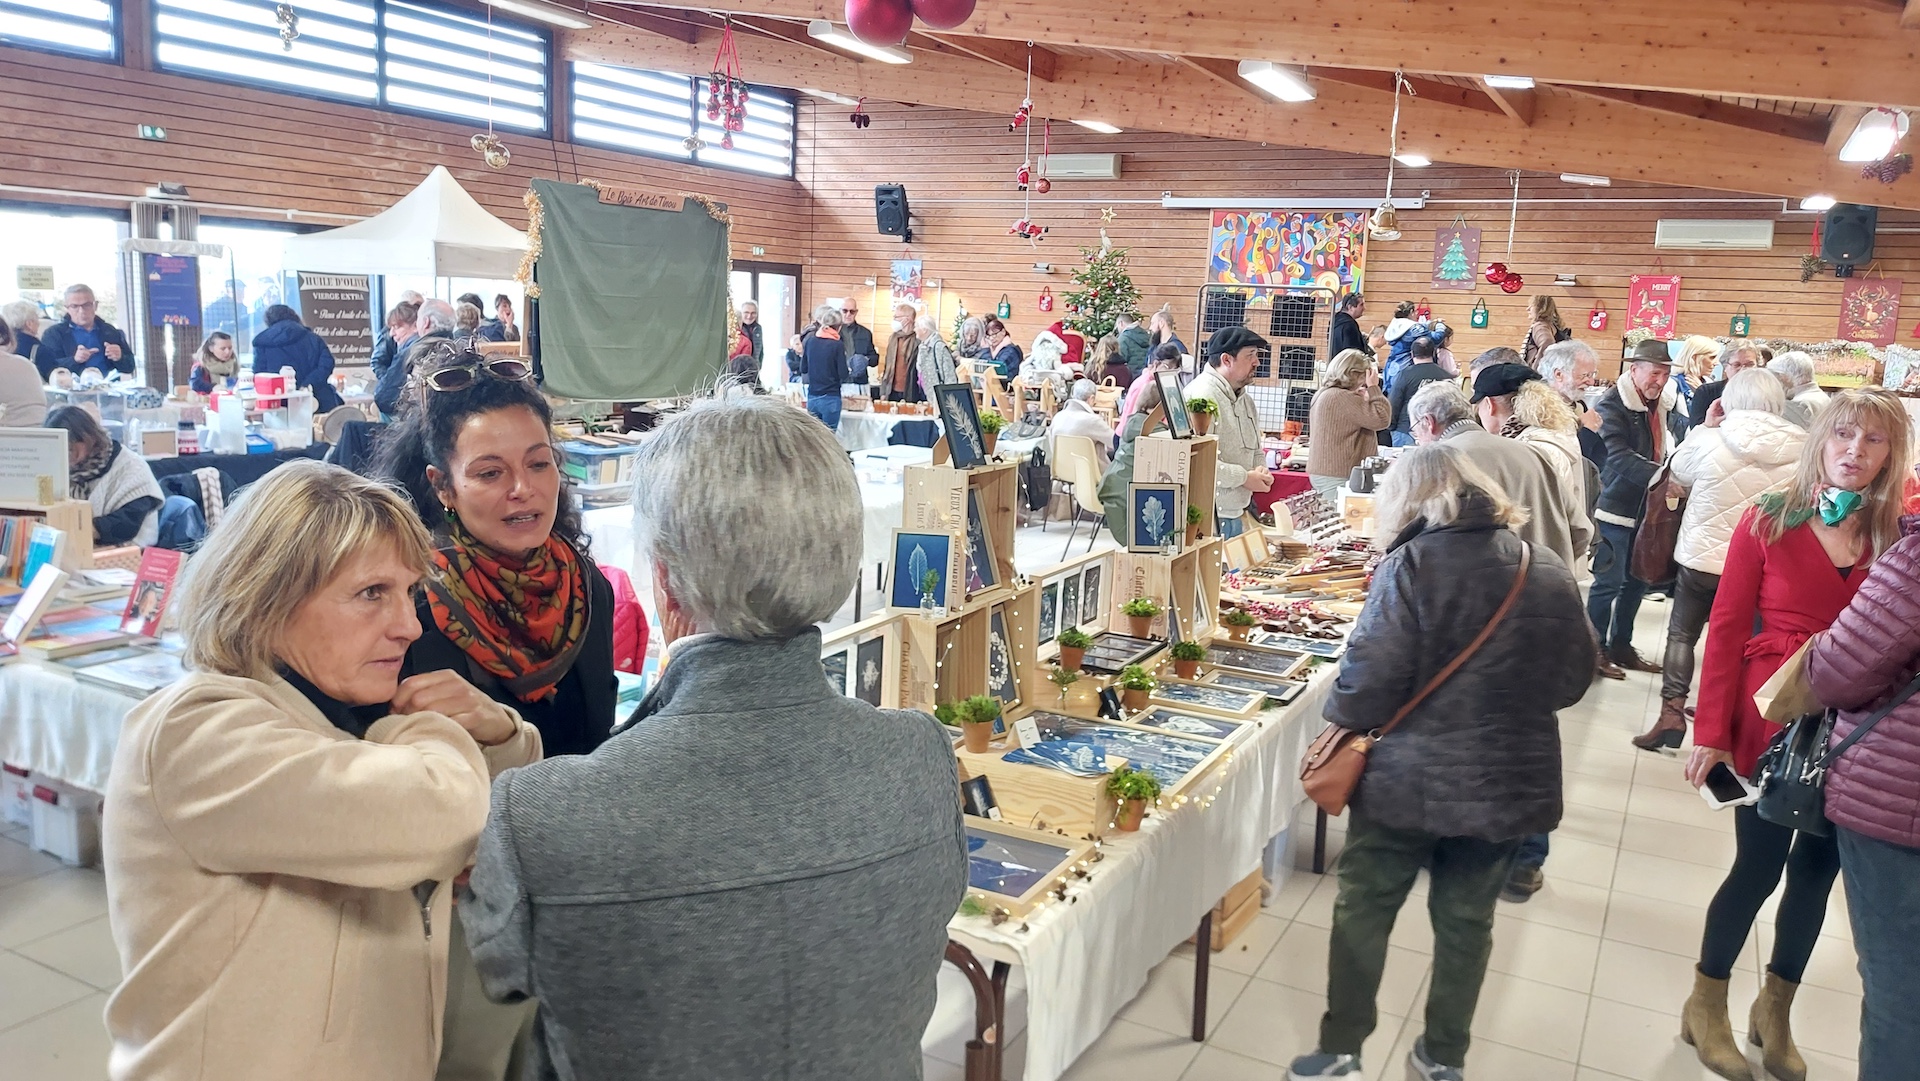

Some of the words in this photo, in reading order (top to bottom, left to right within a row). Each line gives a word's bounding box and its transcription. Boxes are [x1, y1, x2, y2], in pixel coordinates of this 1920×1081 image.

[605, 187, 616, 201] Le
[650, 195, 658, 206] de
[659, 196, 677, 209] Tinou
[305, 276, 334, 286] HUILE
[335, 277, 366, 288] D'OLIVE
[312, 292, 340, 300] VIERGE
[341, 292, 364, 301] EXTRA
